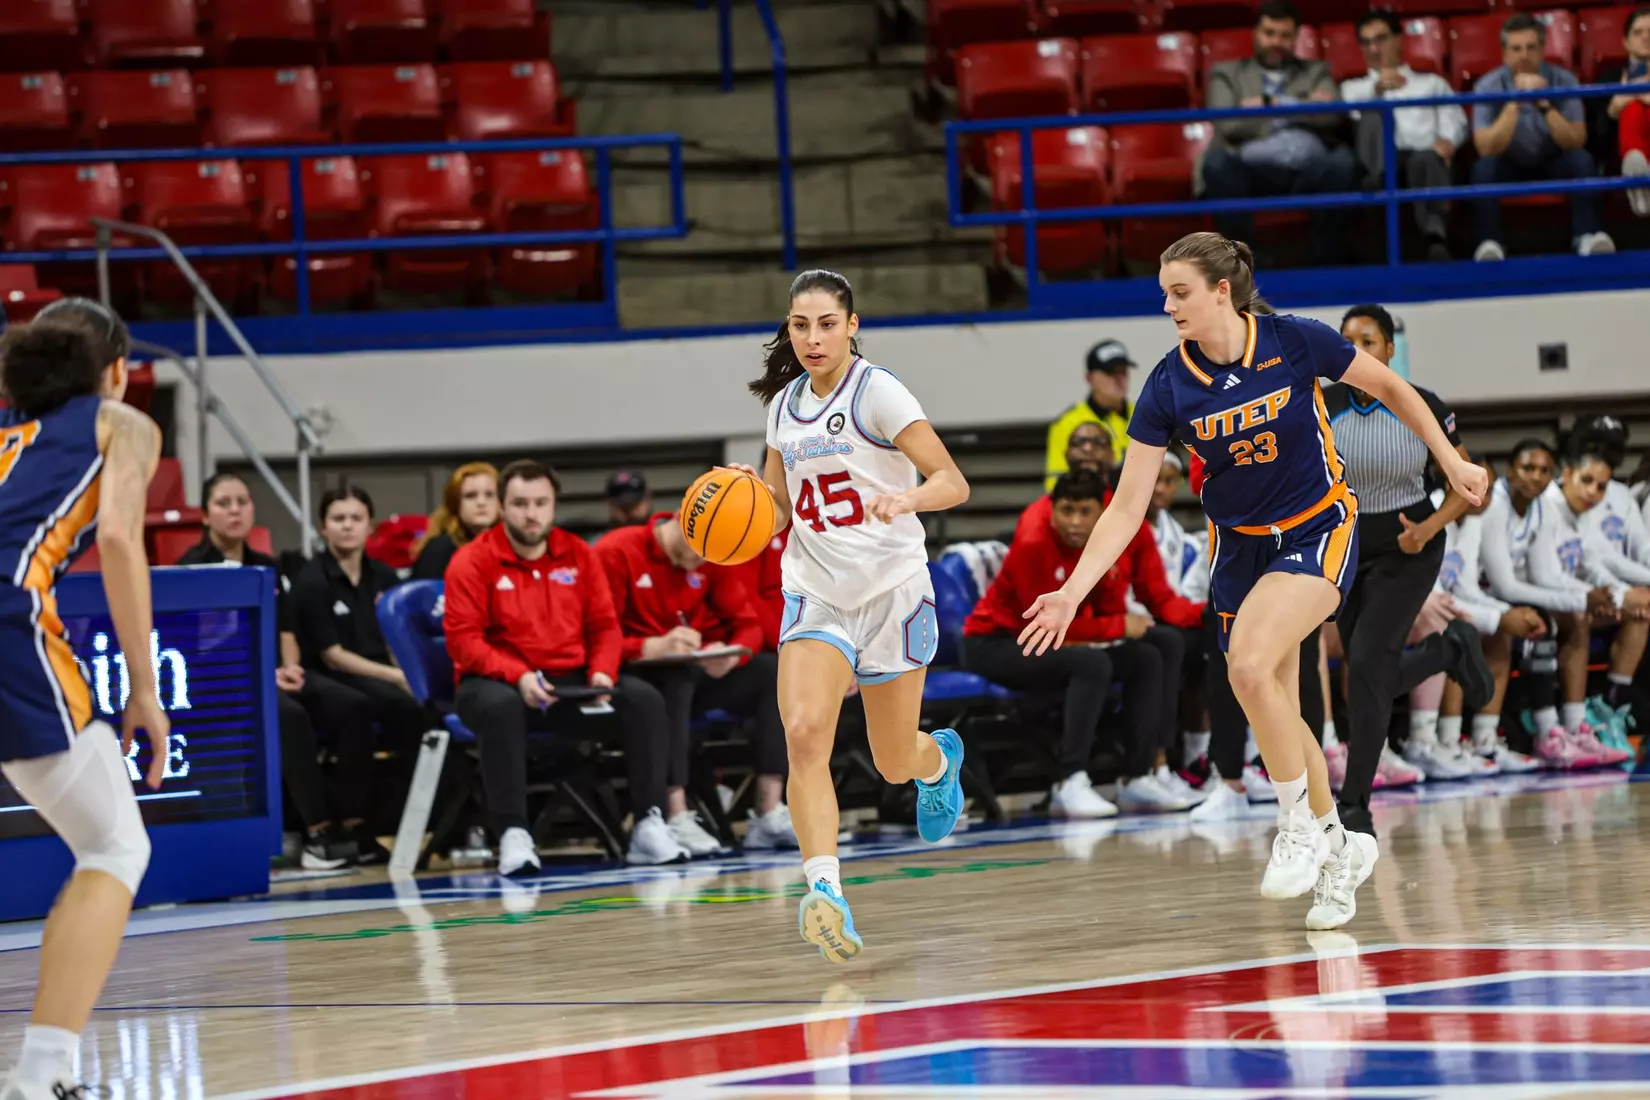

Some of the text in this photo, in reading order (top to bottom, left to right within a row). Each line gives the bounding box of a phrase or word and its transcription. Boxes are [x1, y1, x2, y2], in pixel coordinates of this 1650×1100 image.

[1190, 385, 1291, 440] UTEP
[1228, 431, 1278, 466] 23
[687, 481, 722, 539] Wilson
[794, 470, 865, 533] 45
